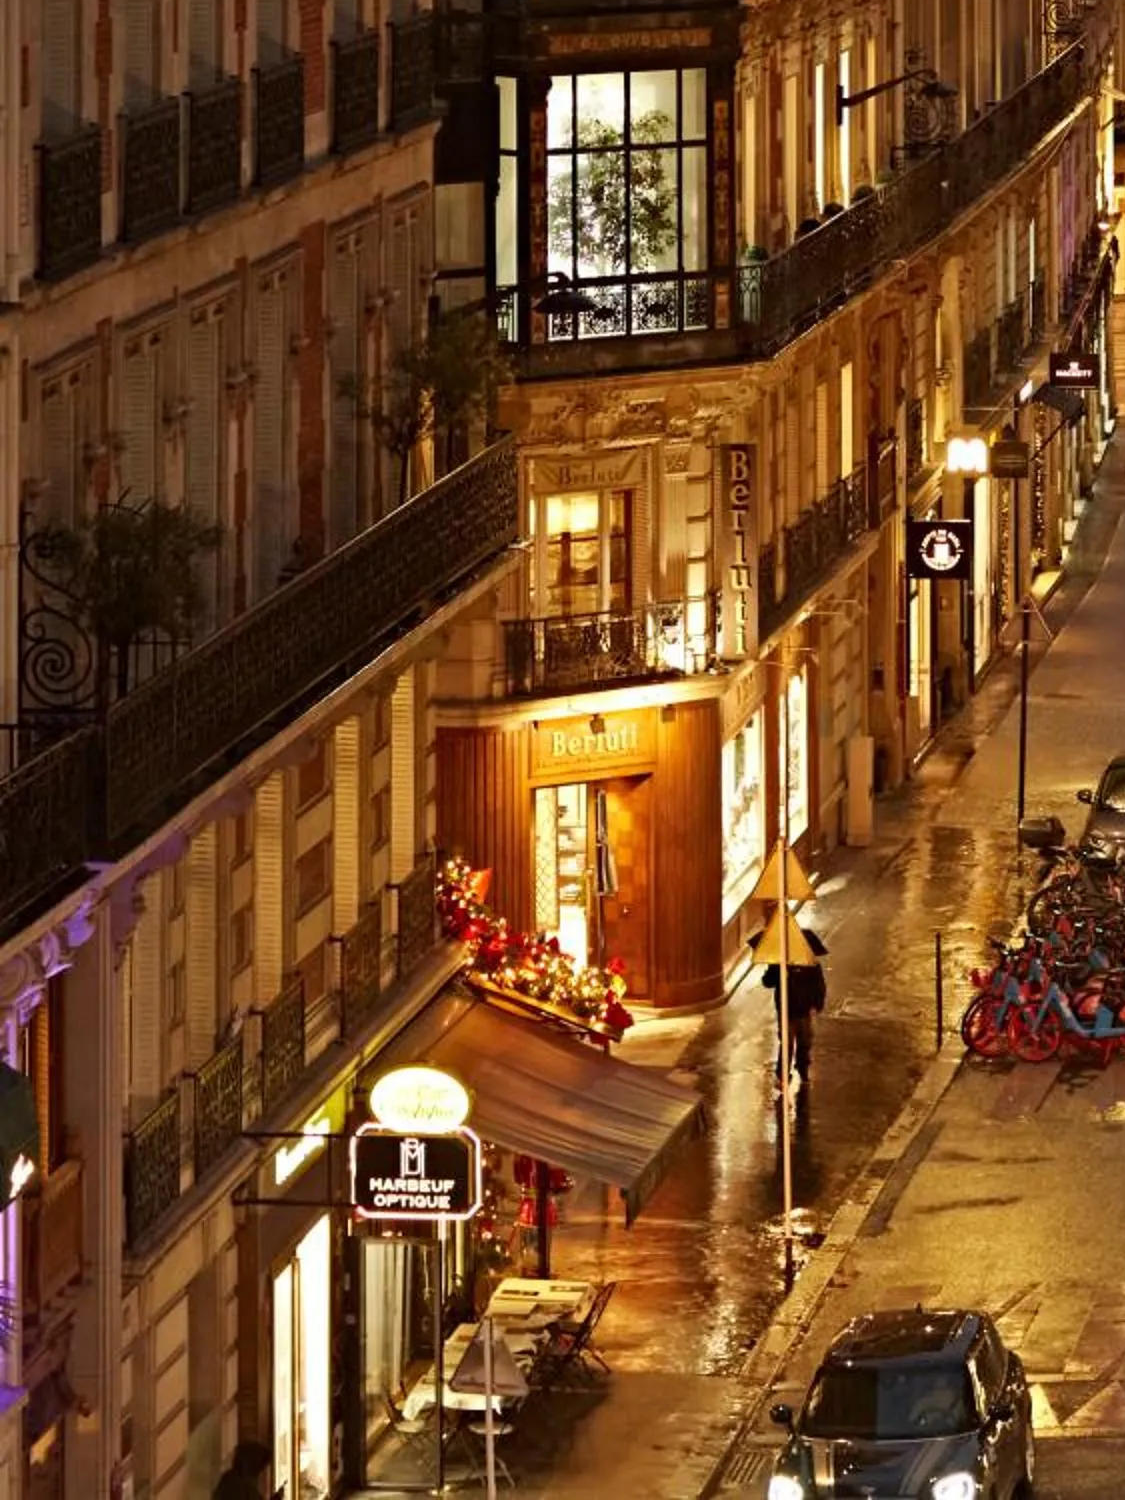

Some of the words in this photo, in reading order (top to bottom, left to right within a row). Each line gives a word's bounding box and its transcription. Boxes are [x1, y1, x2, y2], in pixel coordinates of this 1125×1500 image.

[729, 450, 752, 656] Berluti
[368, 1176, 456, 1193] MARBEUF
[373, 1193, 452, 1209] OPTIQUE
